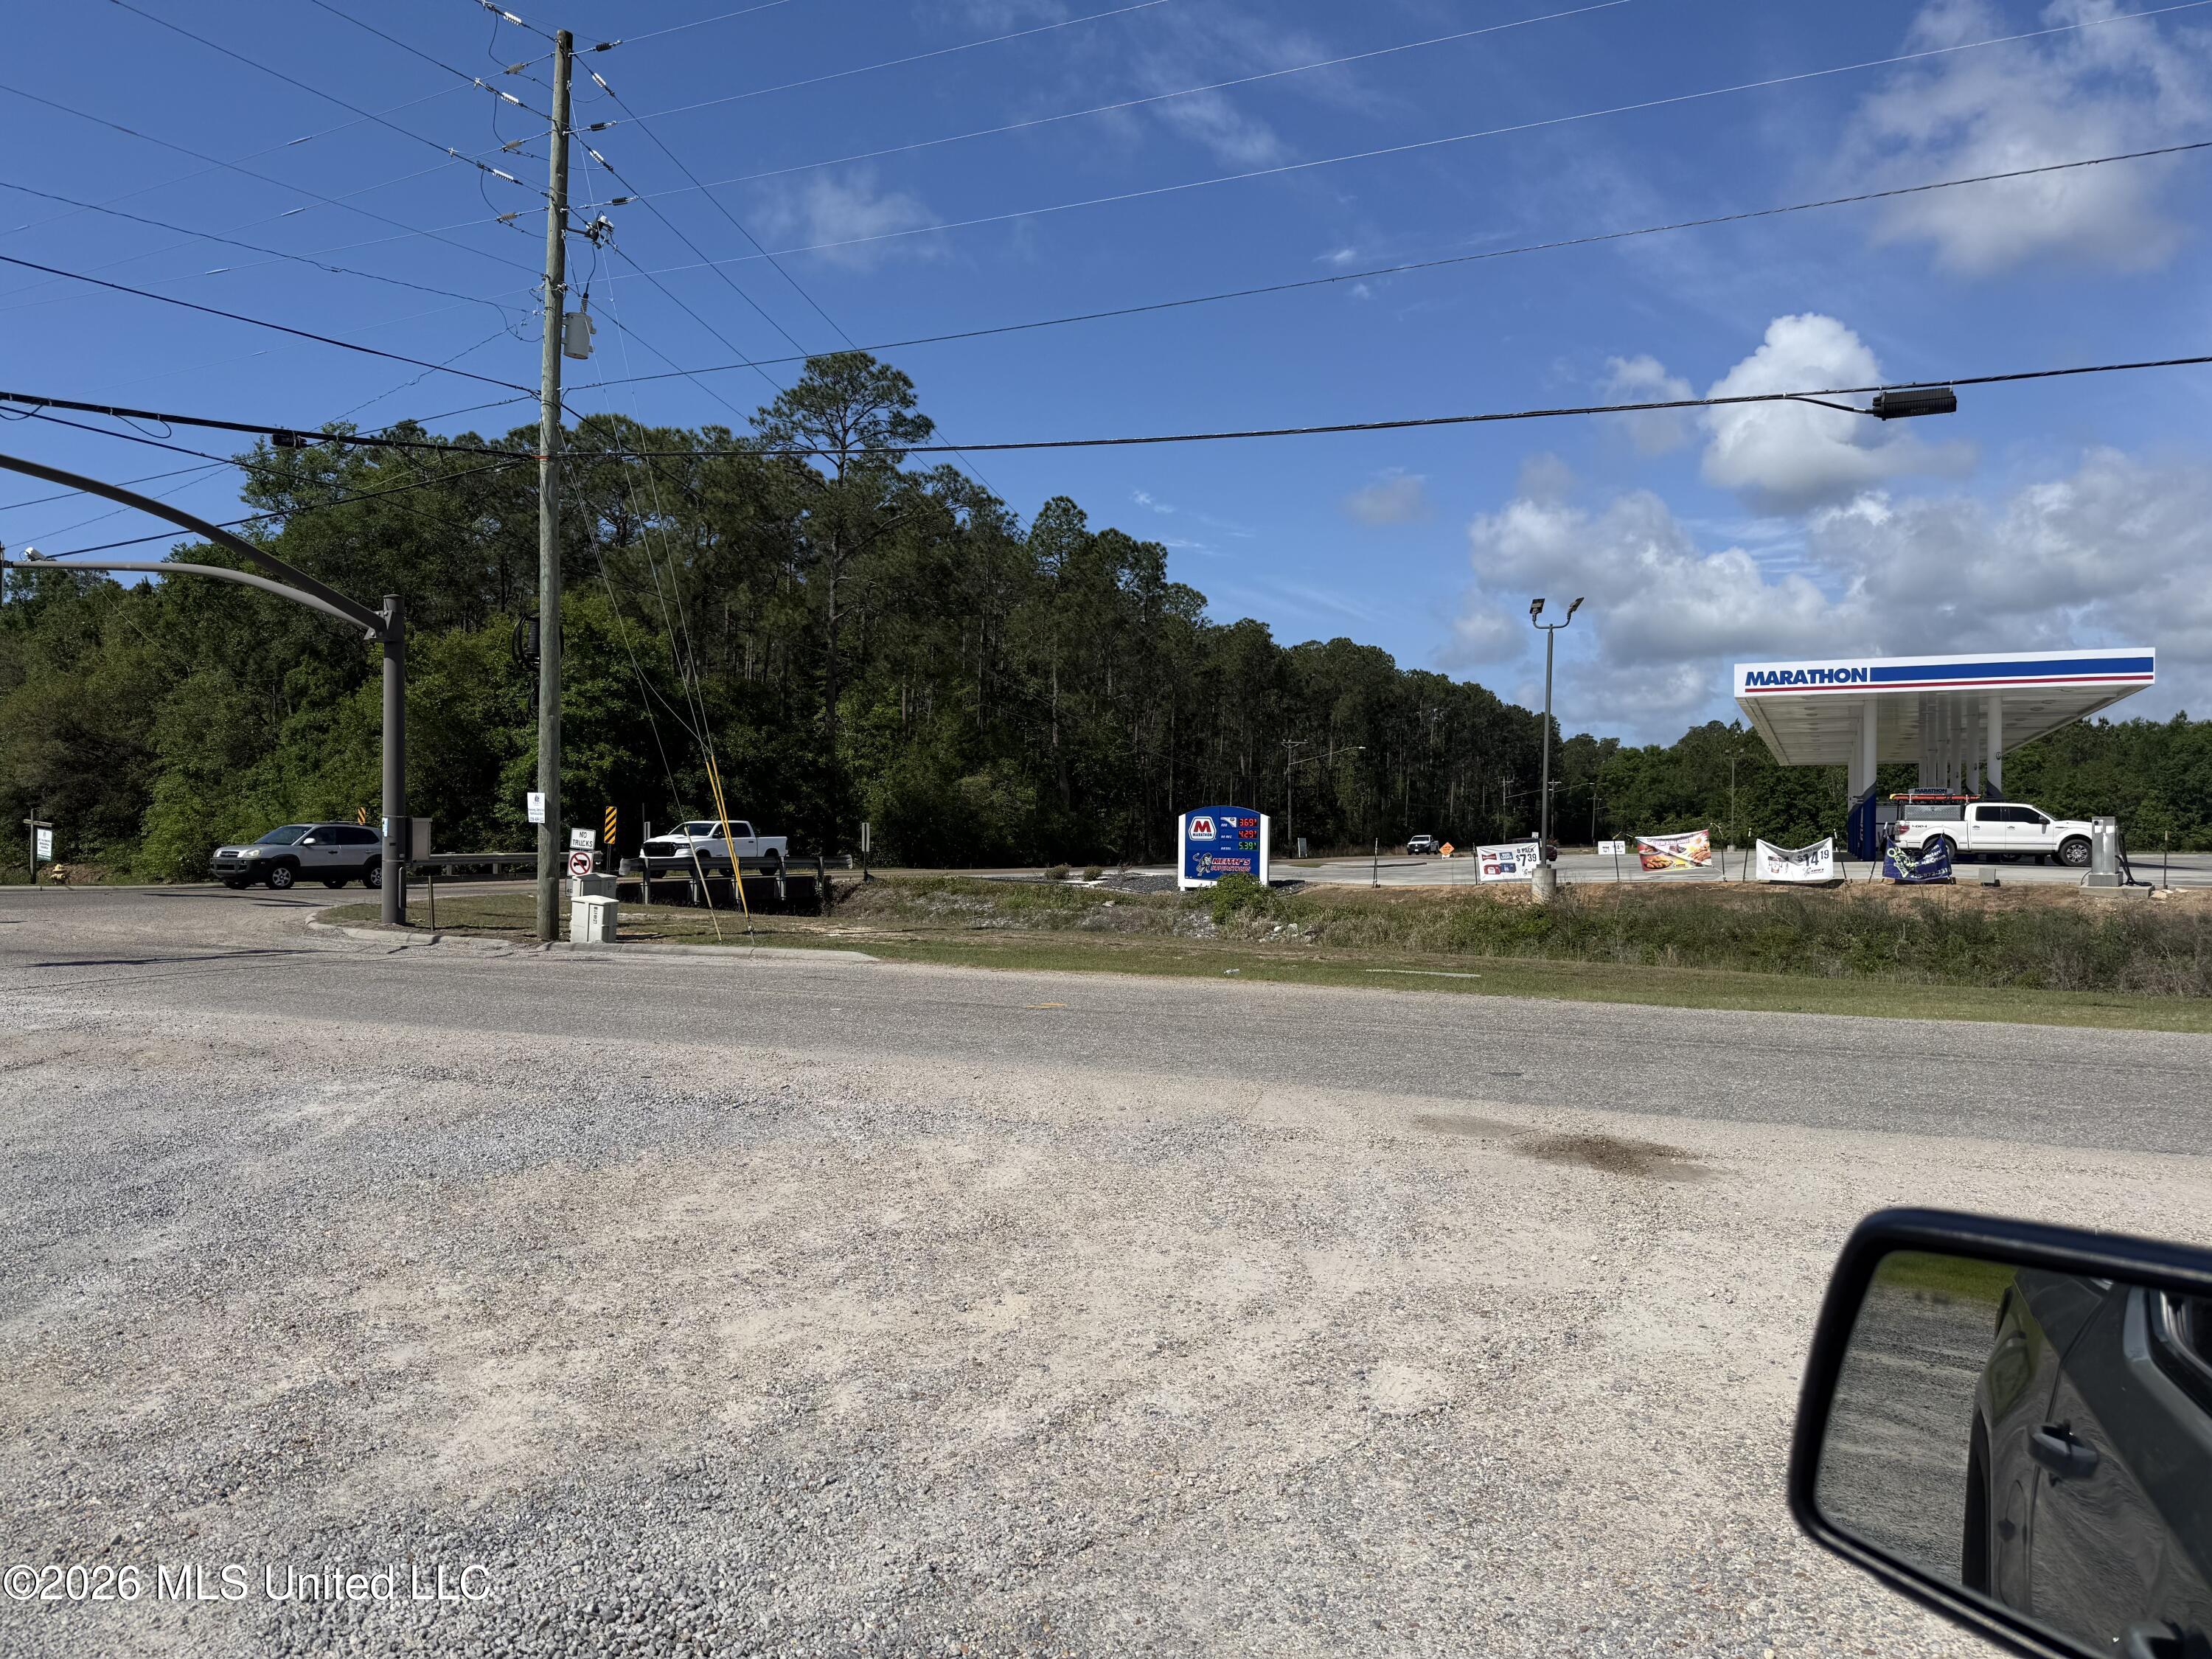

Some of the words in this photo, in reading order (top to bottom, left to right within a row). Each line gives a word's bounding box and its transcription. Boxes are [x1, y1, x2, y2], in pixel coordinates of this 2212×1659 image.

[1745, 667, 1868, 686] MARATHON
[1193, 821, 1211, 832] M
[572, 839, 593, 847] TRUCKS
[1211, 858, 1251, 866] KEITH'S
